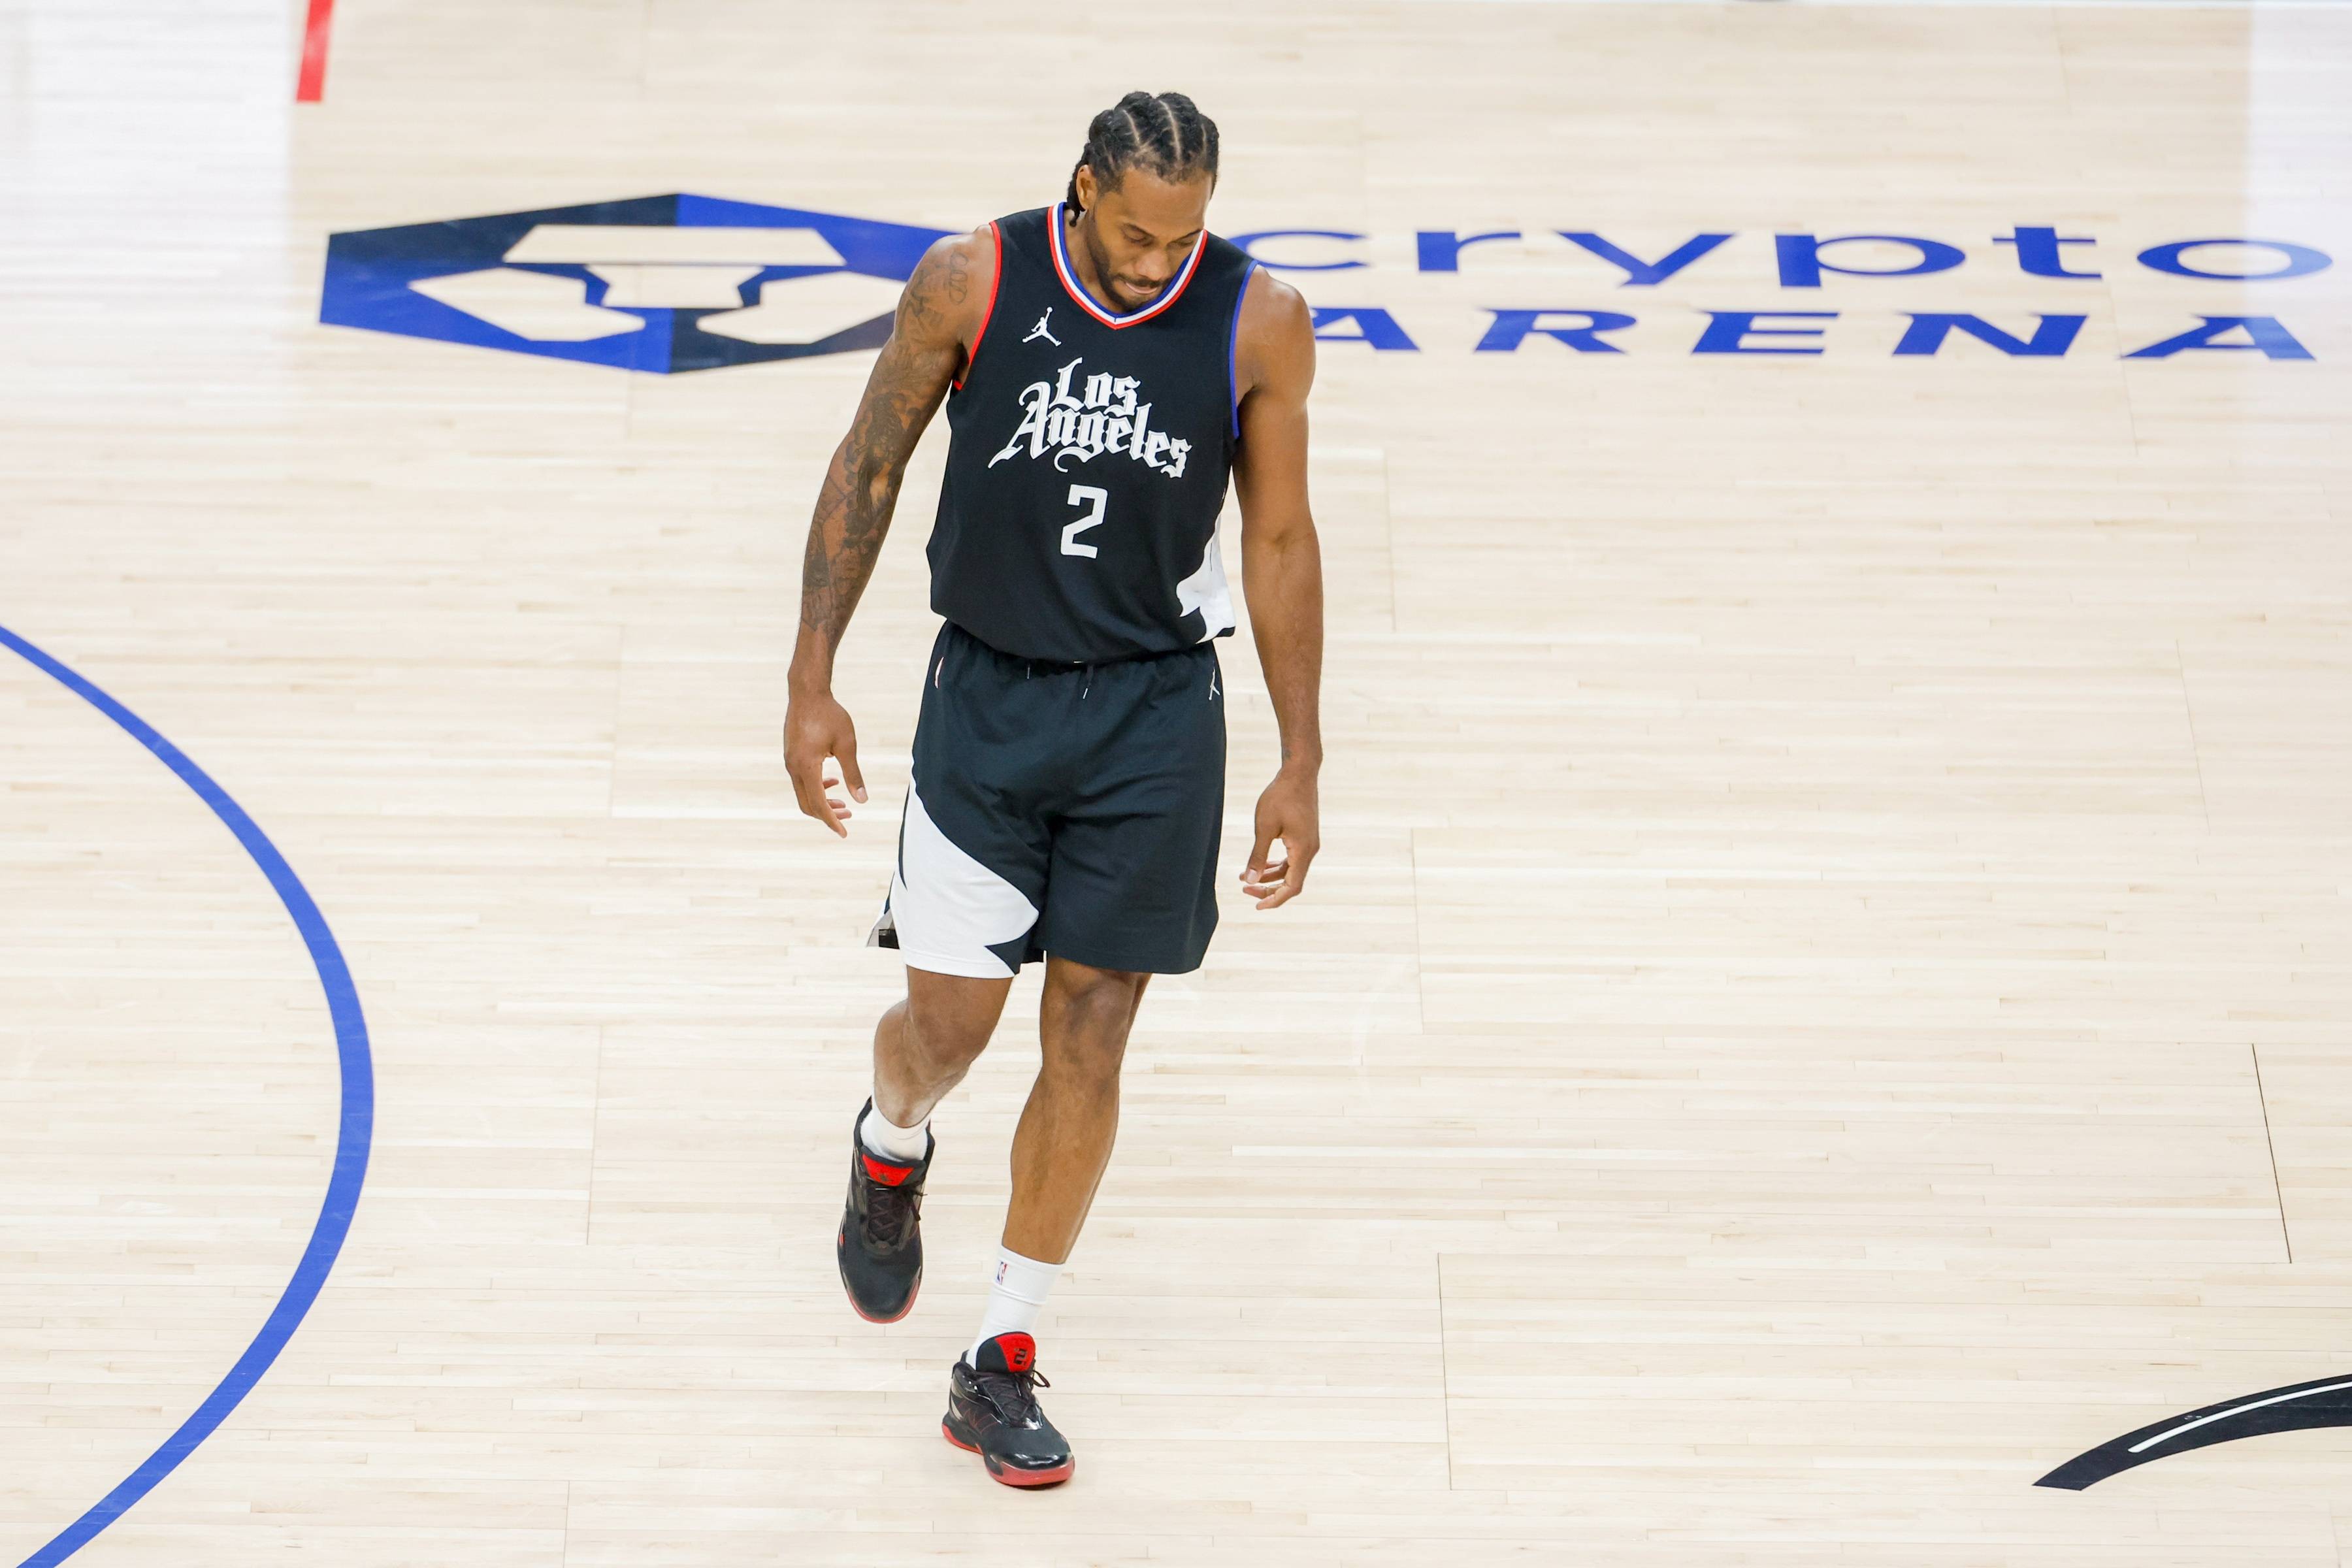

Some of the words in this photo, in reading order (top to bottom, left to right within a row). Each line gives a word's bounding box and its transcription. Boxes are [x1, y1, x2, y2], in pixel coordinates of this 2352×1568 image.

[1222, 225, 2333, 287] crypto
[1311, 308, 2317, 360] ARENA
[1049, 357, 1141, 417] Los
[987, 381, 1192, 478] Angeles
[1060, 484, 1108, 559] 2
